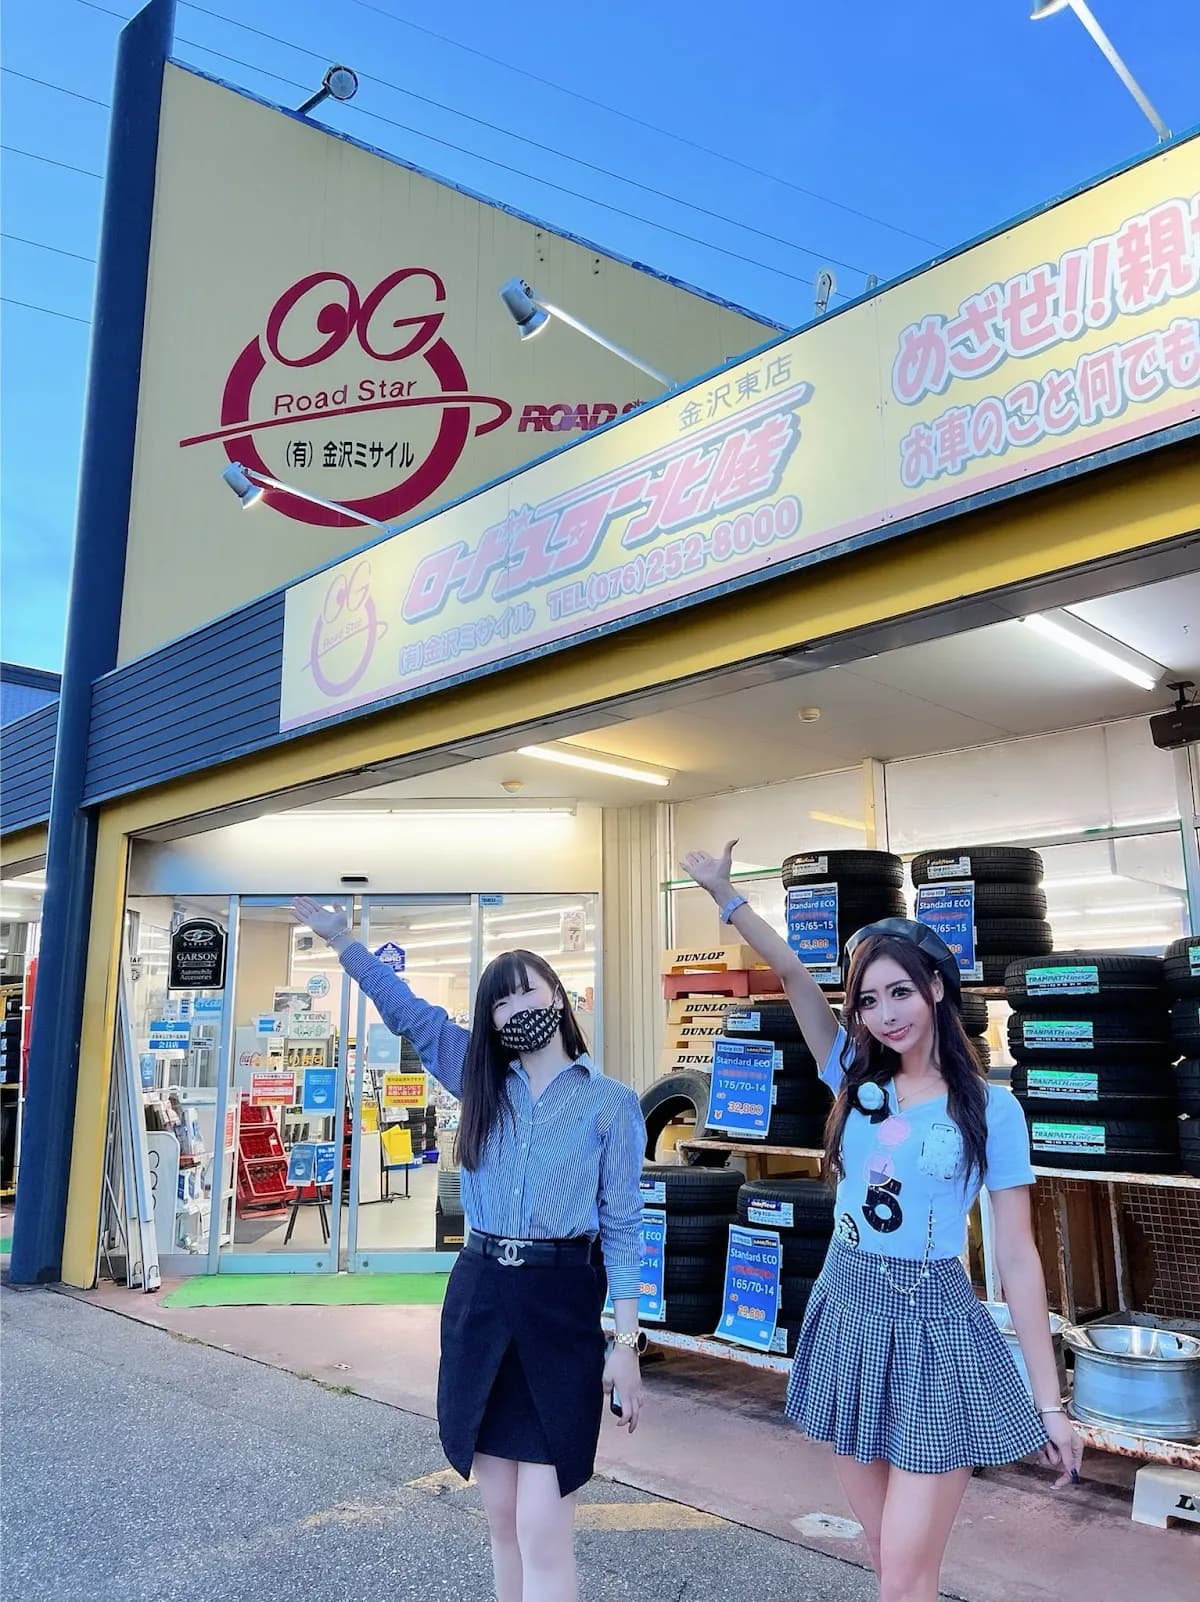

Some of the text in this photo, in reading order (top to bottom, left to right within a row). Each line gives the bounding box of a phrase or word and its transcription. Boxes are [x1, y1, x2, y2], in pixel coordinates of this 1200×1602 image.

[892, 192, 1200, 405] めざせ!!親
[275, 379, 417, 415] Road Star
[679, 353, 794, 432] 金沢東店
[901, 317, 1200, 488] お車のこと何でも
[518, 403, 617, 432] ROAD
[402, 408, 803, 624] ロードスター北陸
[789, 899, 836, 910] Standard ECO
[919, 899, 970, 910] Standard ECO
[790, 920, 834, 931] 195/65-15
[176, 953, 218, 961] GARSON
[676, 951, 725, 962] DUNLOP
[685, 1003, 737, 1012] DUNLO
[303, 1013, 326, 1021] TEIN
[681, 1027, 723, 1036] DUNLO
[677, 1055, 713, 1063] DUNL
[716, 1055, 770, 1067] Standard ECO
[719, 1080, 766, 1092] 175/70-14
[646, 1231, 662, 1241] ECO
[729, 1248, 778, 1265] Standard ECO
[731, 1277, 775, 1296] 165/70-14
